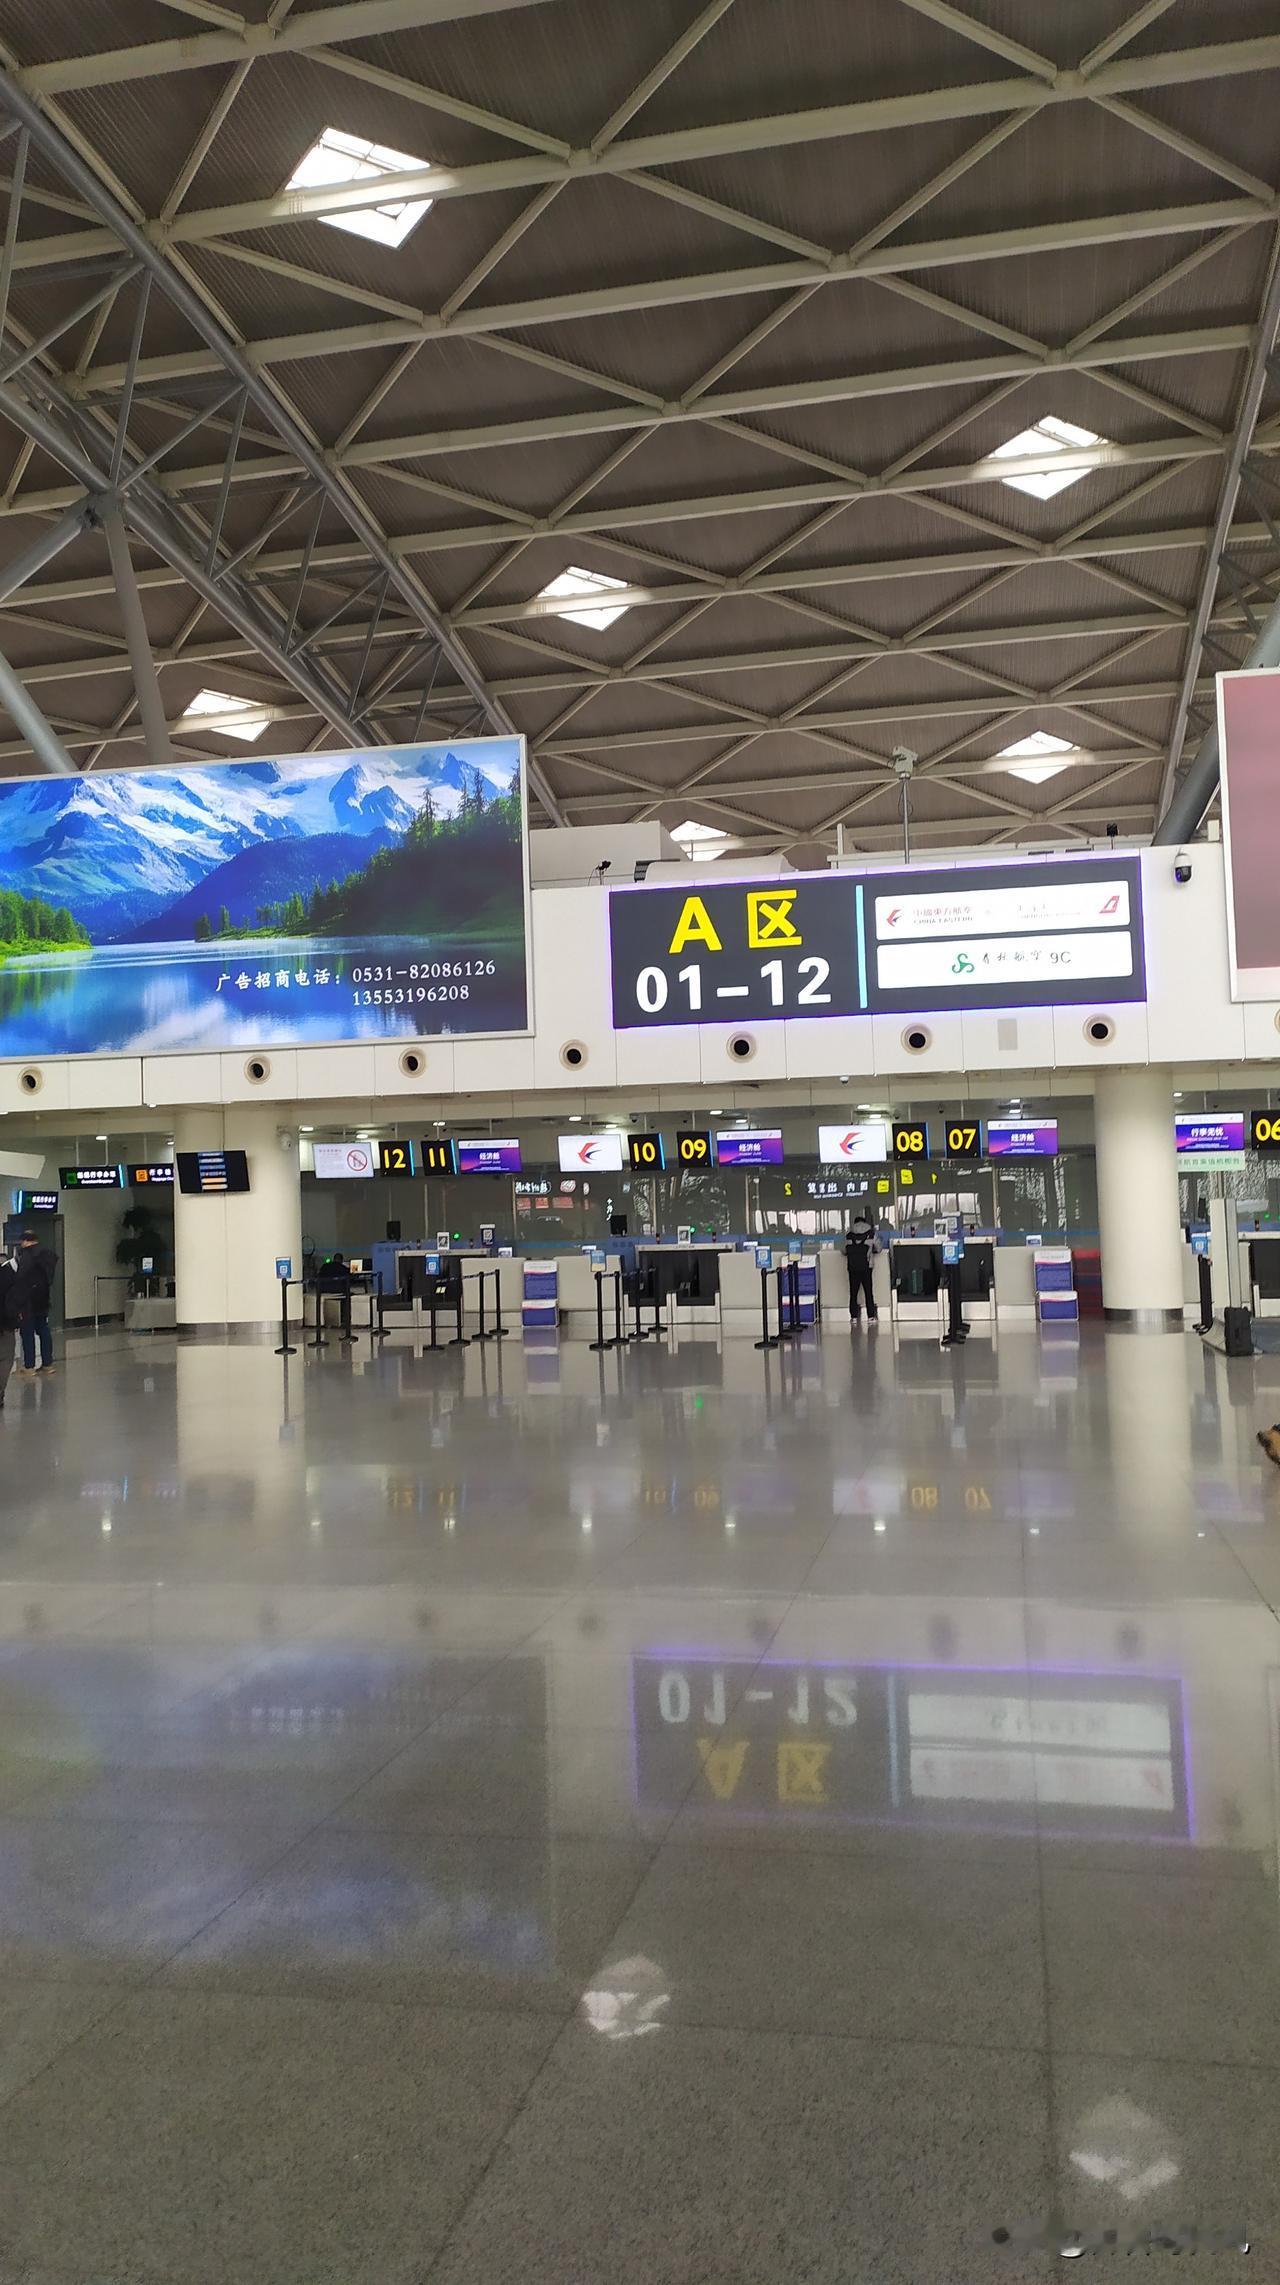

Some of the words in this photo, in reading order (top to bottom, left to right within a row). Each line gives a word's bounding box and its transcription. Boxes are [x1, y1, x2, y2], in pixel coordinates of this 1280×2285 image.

[669, 897, 722, 954] A
[747, 890, 802, 948] 区
[1049, 950, 1072, 965] 9C
[352, 960, 496, 983] 0531-82086126
[352, 984, 470, 1007] 13553196208
[635, 957, 832, 1015] 01-12
[948, 1128, 976, 1150] 07
[1255, 1118, 1280, 1142] 06
[633, 1142, 656, 1163] 10
[681, 1138, 707, 1160] 09
[896, 1131, 924, 1153] 08
[383, 1148, 406, 1169] 12
[428, 1147, 446, 1168] 11
